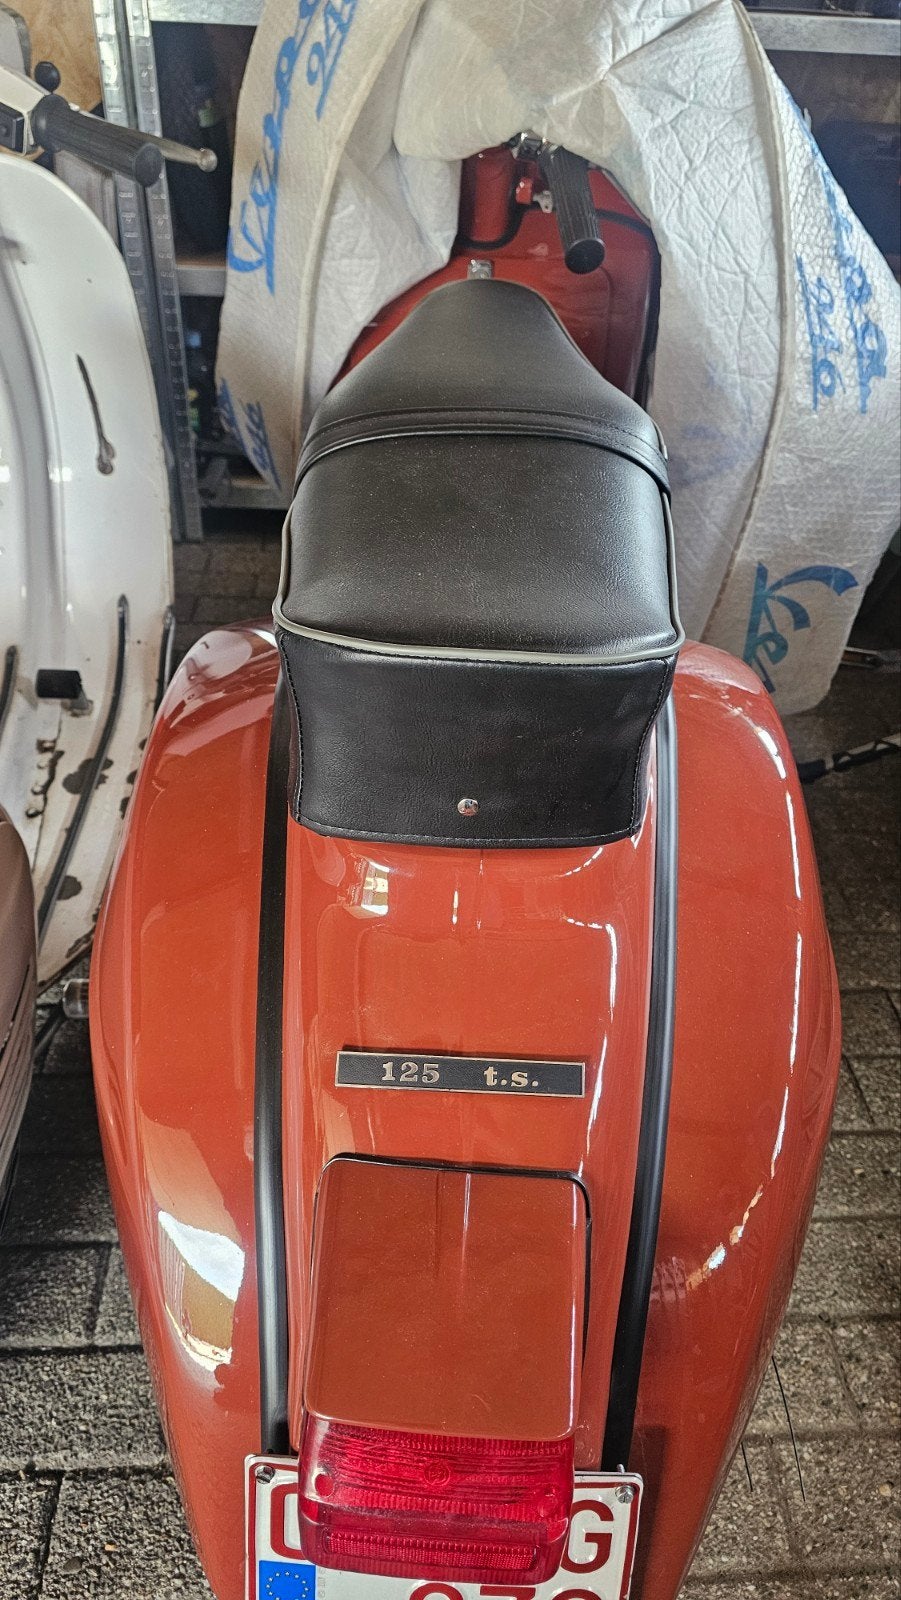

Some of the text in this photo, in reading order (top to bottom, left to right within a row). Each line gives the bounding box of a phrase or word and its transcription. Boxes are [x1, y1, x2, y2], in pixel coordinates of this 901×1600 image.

[306, 0, 358, 122] 94
[228, 0, 318, 296] Vesp
[381, 1061, 540, 1088] 125 t.s.
